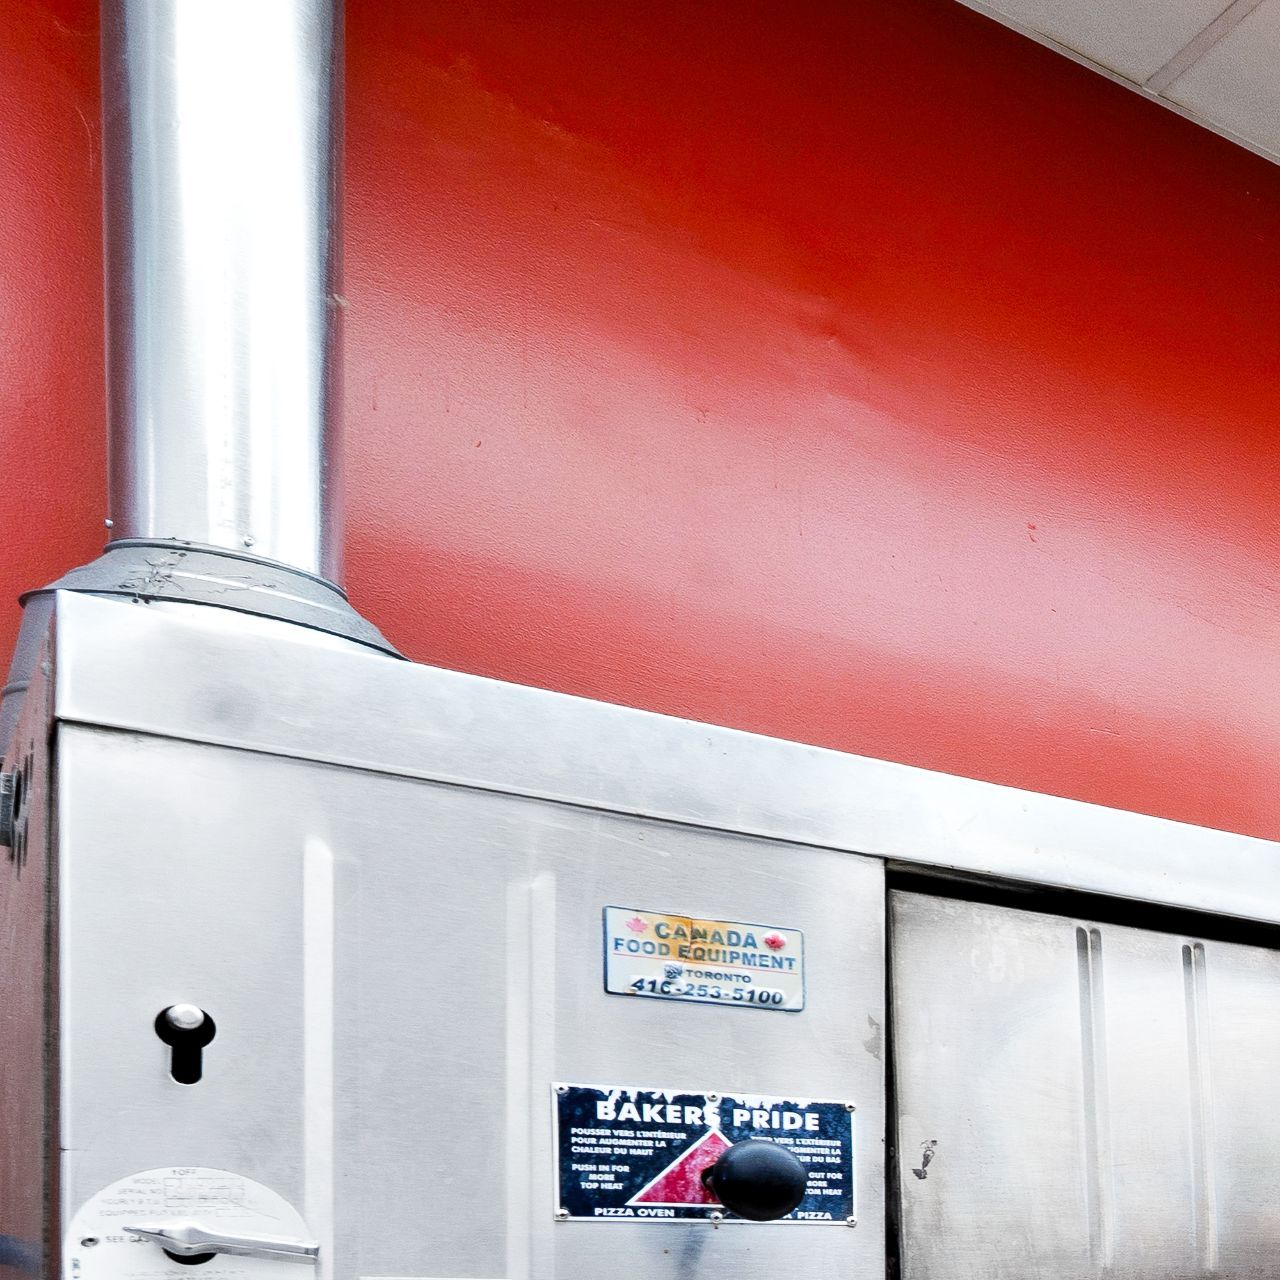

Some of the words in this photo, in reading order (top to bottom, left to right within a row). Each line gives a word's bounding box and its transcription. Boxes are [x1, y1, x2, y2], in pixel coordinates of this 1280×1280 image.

[654, 921, 759, 950] CANADA
[613, 937, 671, 956] FOOD
[678, 943, 796, 971] EQUIPMENT
[686, 968, 752, 984] TORONTO
[631, 977, 784, 1005] 416-253-5100
[596, 1100, 720, 1127] BAKERS
[732, 1108, 820, 1131] PRIDE
[571, 1127, 612, 1137] POUSSER
[613, 1129, 635, 1138] VERS
[571, 1137, 597, 1145] POUR
[599, 1138, 654, 1147] AUGMENTER
[655, 1140, 667, 1148] LA
[571, 1146, 612, 1155] CHALEUR
[613, 1147, 628, 1155] DU
[629, 1148, 654, 1156] HAUT
[571, 1164, 597, 1172] PUSH
[598, 1164, 610, 1172] IN
[611, 1165, 631, 1173] FOR
[588, 1173, 616, 1181] MORE
[826, 1172, 843, 1180] FOR
[580, 1182, 599, 1190] TOP
[600, 1182, 625, 1190] HEAT
[594, 1207, 635, 1217] PIZZA
[637, 1208, 676, 1217] OVEN
[797, 1211, 833, 1220] PIZZA
